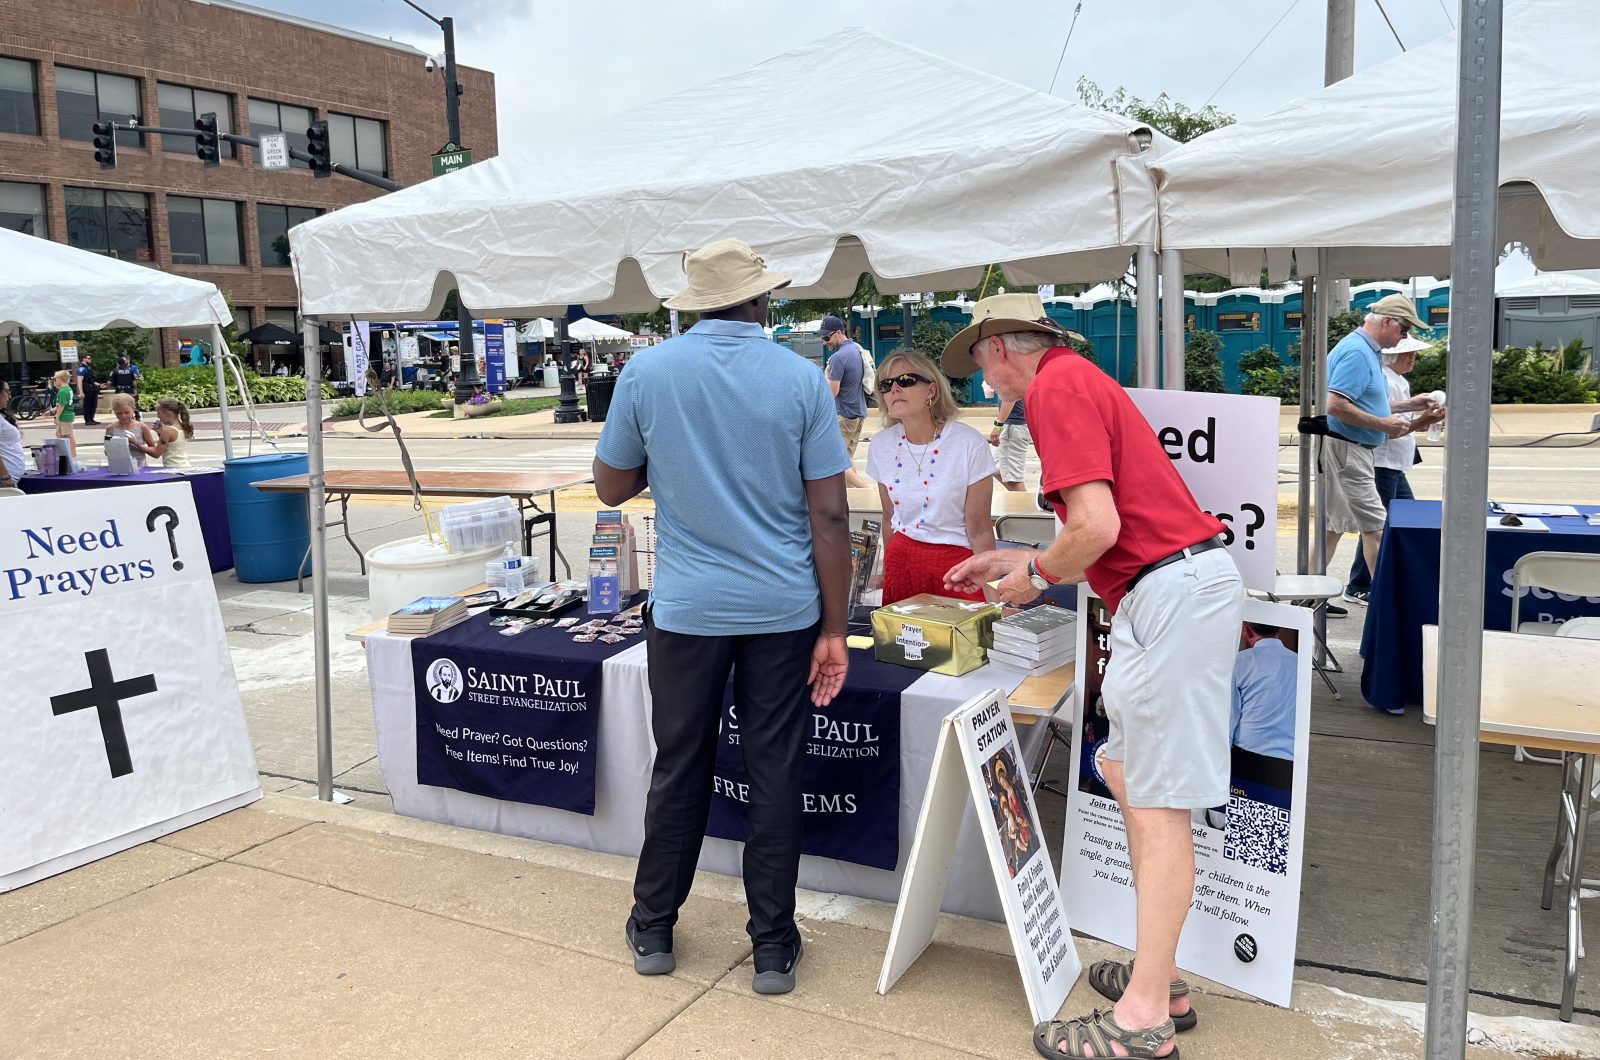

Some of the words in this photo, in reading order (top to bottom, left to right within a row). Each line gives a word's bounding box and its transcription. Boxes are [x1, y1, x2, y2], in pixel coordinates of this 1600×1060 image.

[440, 154, 463, 166] MAIN
[21, 519, 124, 559] Need
[3, 558, 155, 601] Prayers
[901, 623, 922, 634] Prayer
[467, 667, 528, 693] SAINT
[533, 673, 587, 698] PAUL
[468, 692, 500, 705] STREET
[502, 696, 587, 712] EVANGELIZATION
[971, 700, 1001, 731] PRAYER
[436, 722, 459, 739] Need
[462, 727, 500, 745] Prayer?
[502, 734, 523, 748] Got
[526, 737, 588, 752] Questions?
[812, 714, 879, 743] PAUL
[976, 718, 1008, 752] STATION
[445, 744, 463, 760] Free
[466, 749, 500, 764] Items!
[502, 754, 527, 768] Find
[529, 756, 555, 770] True
[558, 759, 579, 775] Joy!
[1089, 798, 1107, 809] Join
[1108, 803, 1121, 813] the
[1083, 831, 1113, 850] Passing
[1114, 841, 1127, 852] the
[1208, 870, 1244, 889] children
[1246, 882, 1254, 892] is
[1255, 885, 1271, 897] the
[1079, 848, 1103, 862] single,
[1195, 884, 1215, 896] offer
[1216, 890, 1240, 906] them.
[1244, 898, 1271, 916] When
[1093, 869, 1110, 880] you
[1110, 872, 1129, 886] lead
[1203, 904, 1220, 916] will
[1219, 909, 1249, 927] follow.
